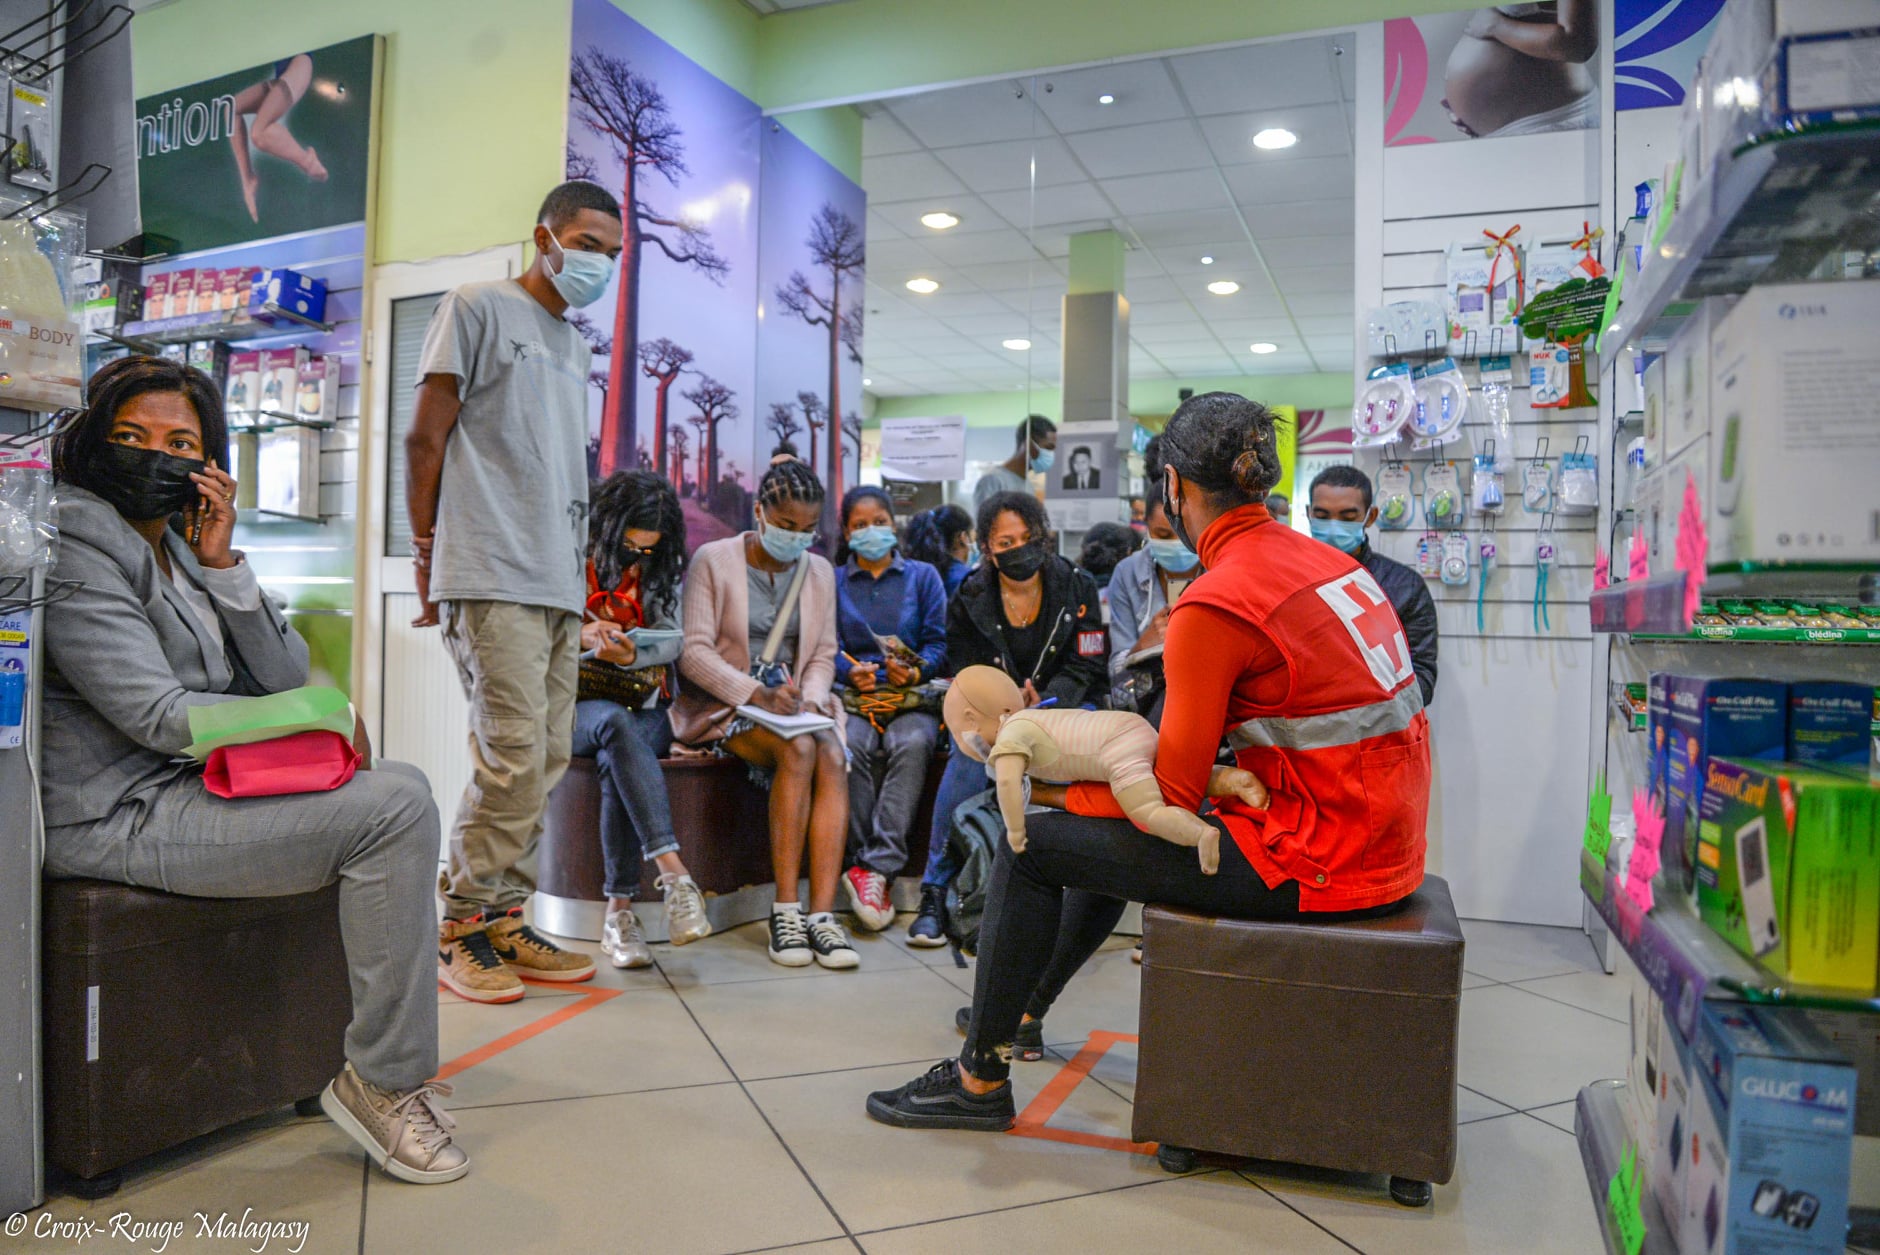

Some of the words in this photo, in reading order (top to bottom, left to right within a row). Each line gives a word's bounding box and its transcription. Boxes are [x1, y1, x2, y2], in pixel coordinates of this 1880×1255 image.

[29, 326, 75, 346] BODY
[1533, 351, 1551, 360] NUK
[1808, 630, 1843, 639] blédina
